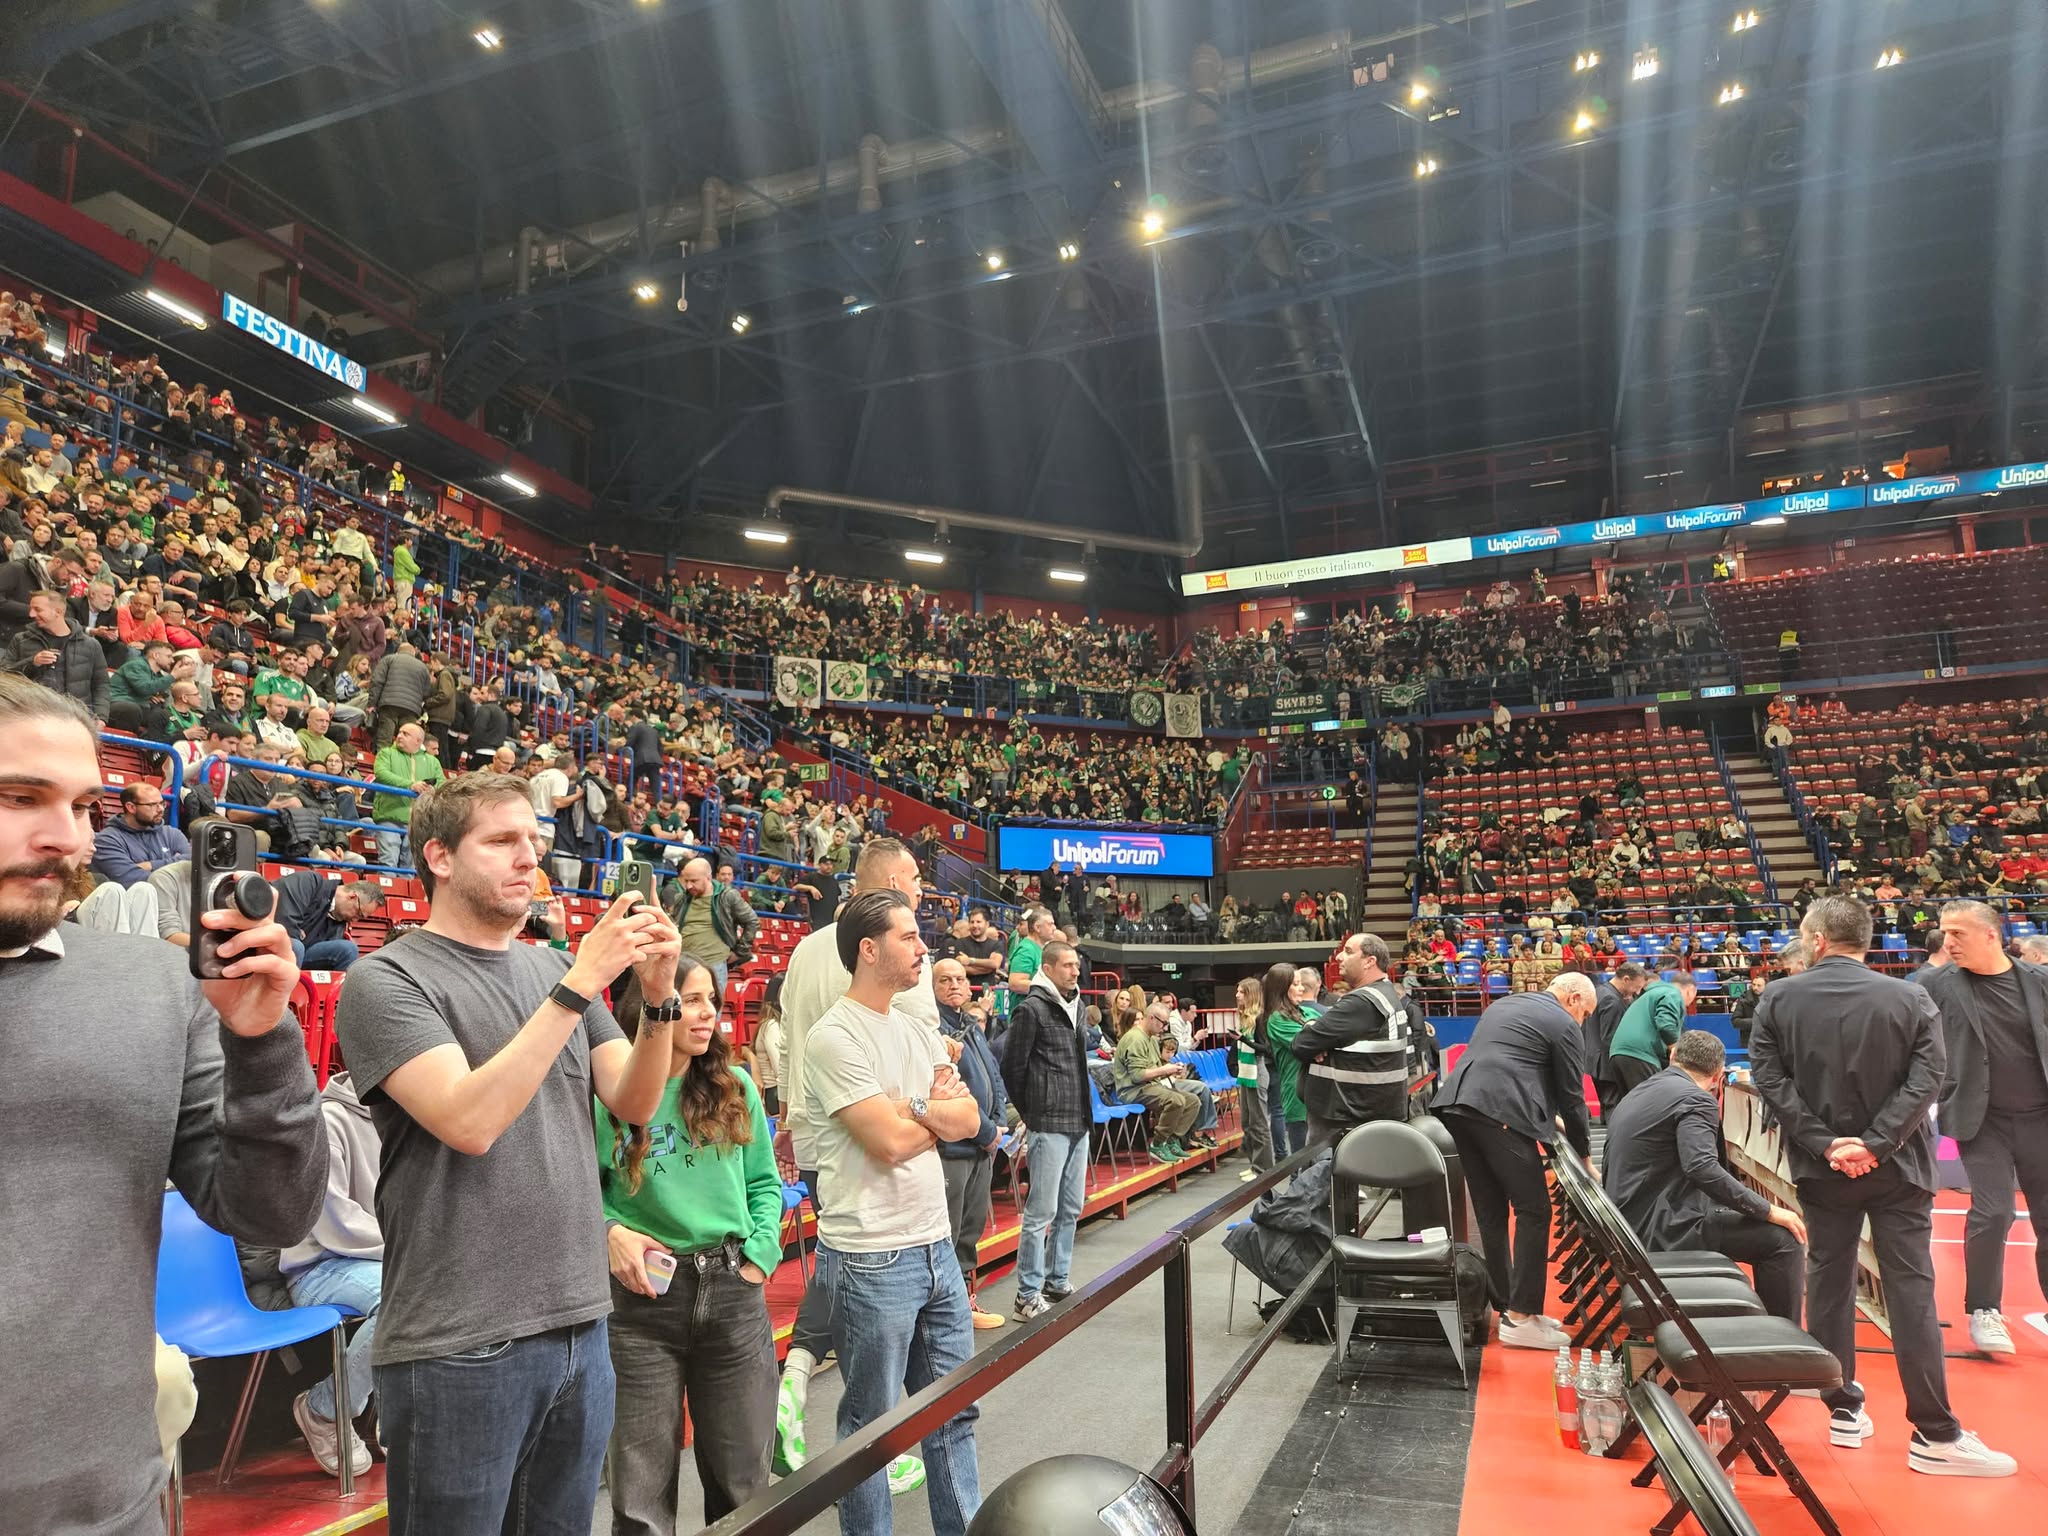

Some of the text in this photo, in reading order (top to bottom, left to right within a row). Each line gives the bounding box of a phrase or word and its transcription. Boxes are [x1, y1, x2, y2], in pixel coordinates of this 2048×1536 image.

[226, 295, 345, 382] FESTINA
[1784, 493, 1829, 513] Unipol
[1873, 481, 1956, 504] UnipolForum
[1595, 518, 1636, 538] Unipol
[1665, 509, 1742, 531] UnipolForum
[1487, 533, 1557, 555] UnipolForum
[1254, 558, 1375, 583] Il buon gusto italiano.
[1708, 688, 1726, 697] BAR
[1053, 838, 1159, 870] UnipolForum
[316, 973, 326, 982] 15
[1734, 986, 1742, 995] A
[653, 1147, 741, 1177] ARIS
